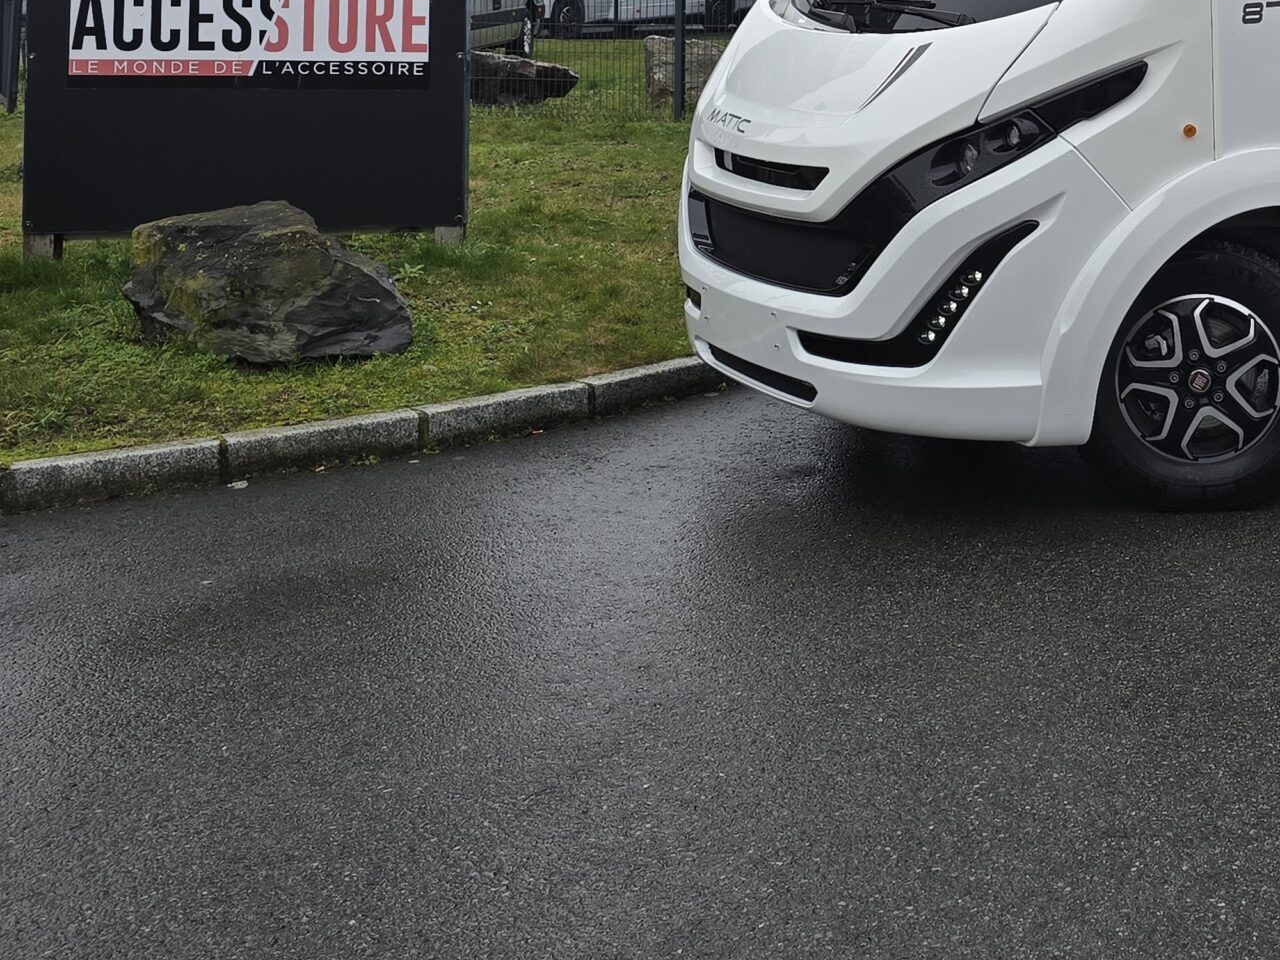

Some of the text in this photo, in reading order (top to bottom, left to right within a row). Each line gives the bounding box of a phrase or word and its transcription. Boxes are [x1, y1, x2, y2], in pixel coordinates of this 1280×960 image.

[72, 60, 424, 76] LE MONDE DE L'ACCESSOIRE
[708, 108, 751, 134] MATIC
